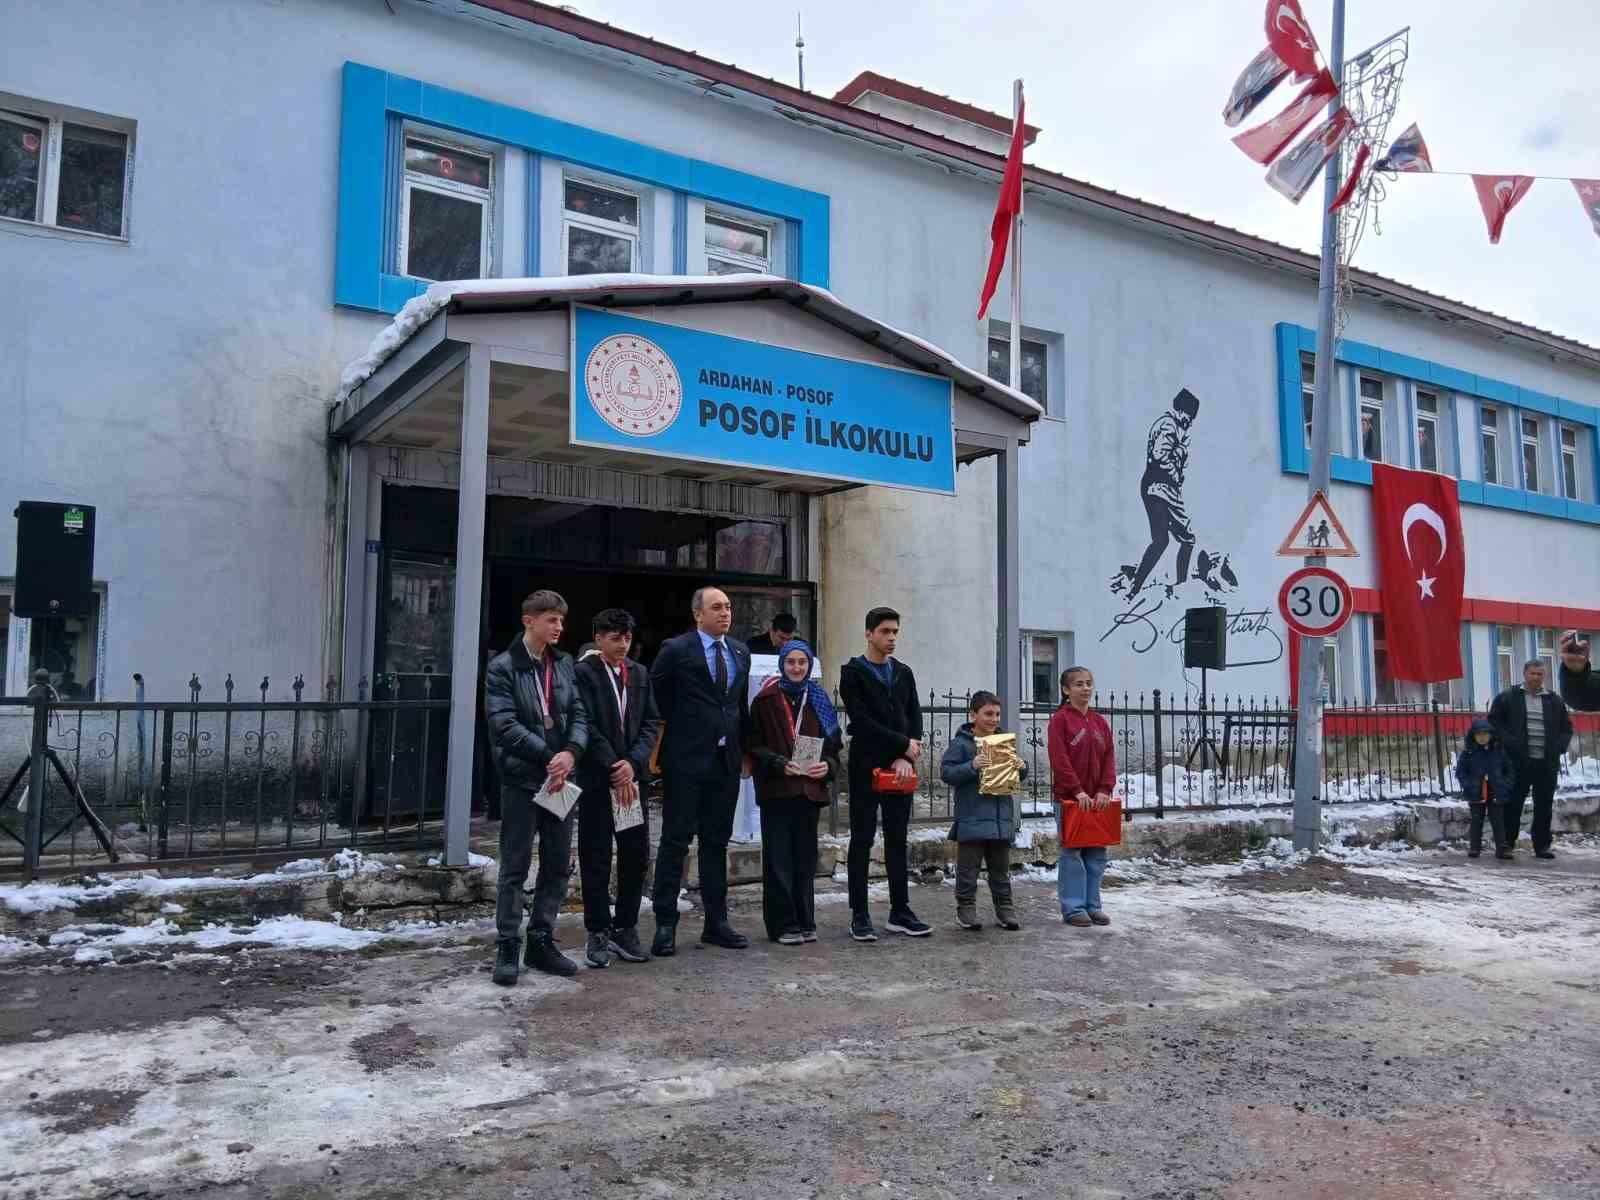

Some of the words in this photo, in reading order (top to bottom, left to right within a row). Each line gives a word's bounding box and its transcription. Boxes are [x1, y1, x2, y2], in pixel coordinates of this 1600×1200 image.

[698, 368, 773, 396] ARDAHAN
[786, 384, 834, 406] POSOF
[698, 399, 796, 440] POSOF
[805, 409, 934, 463] İLKOKULU
[1291, 586, 1340, 617] 30
